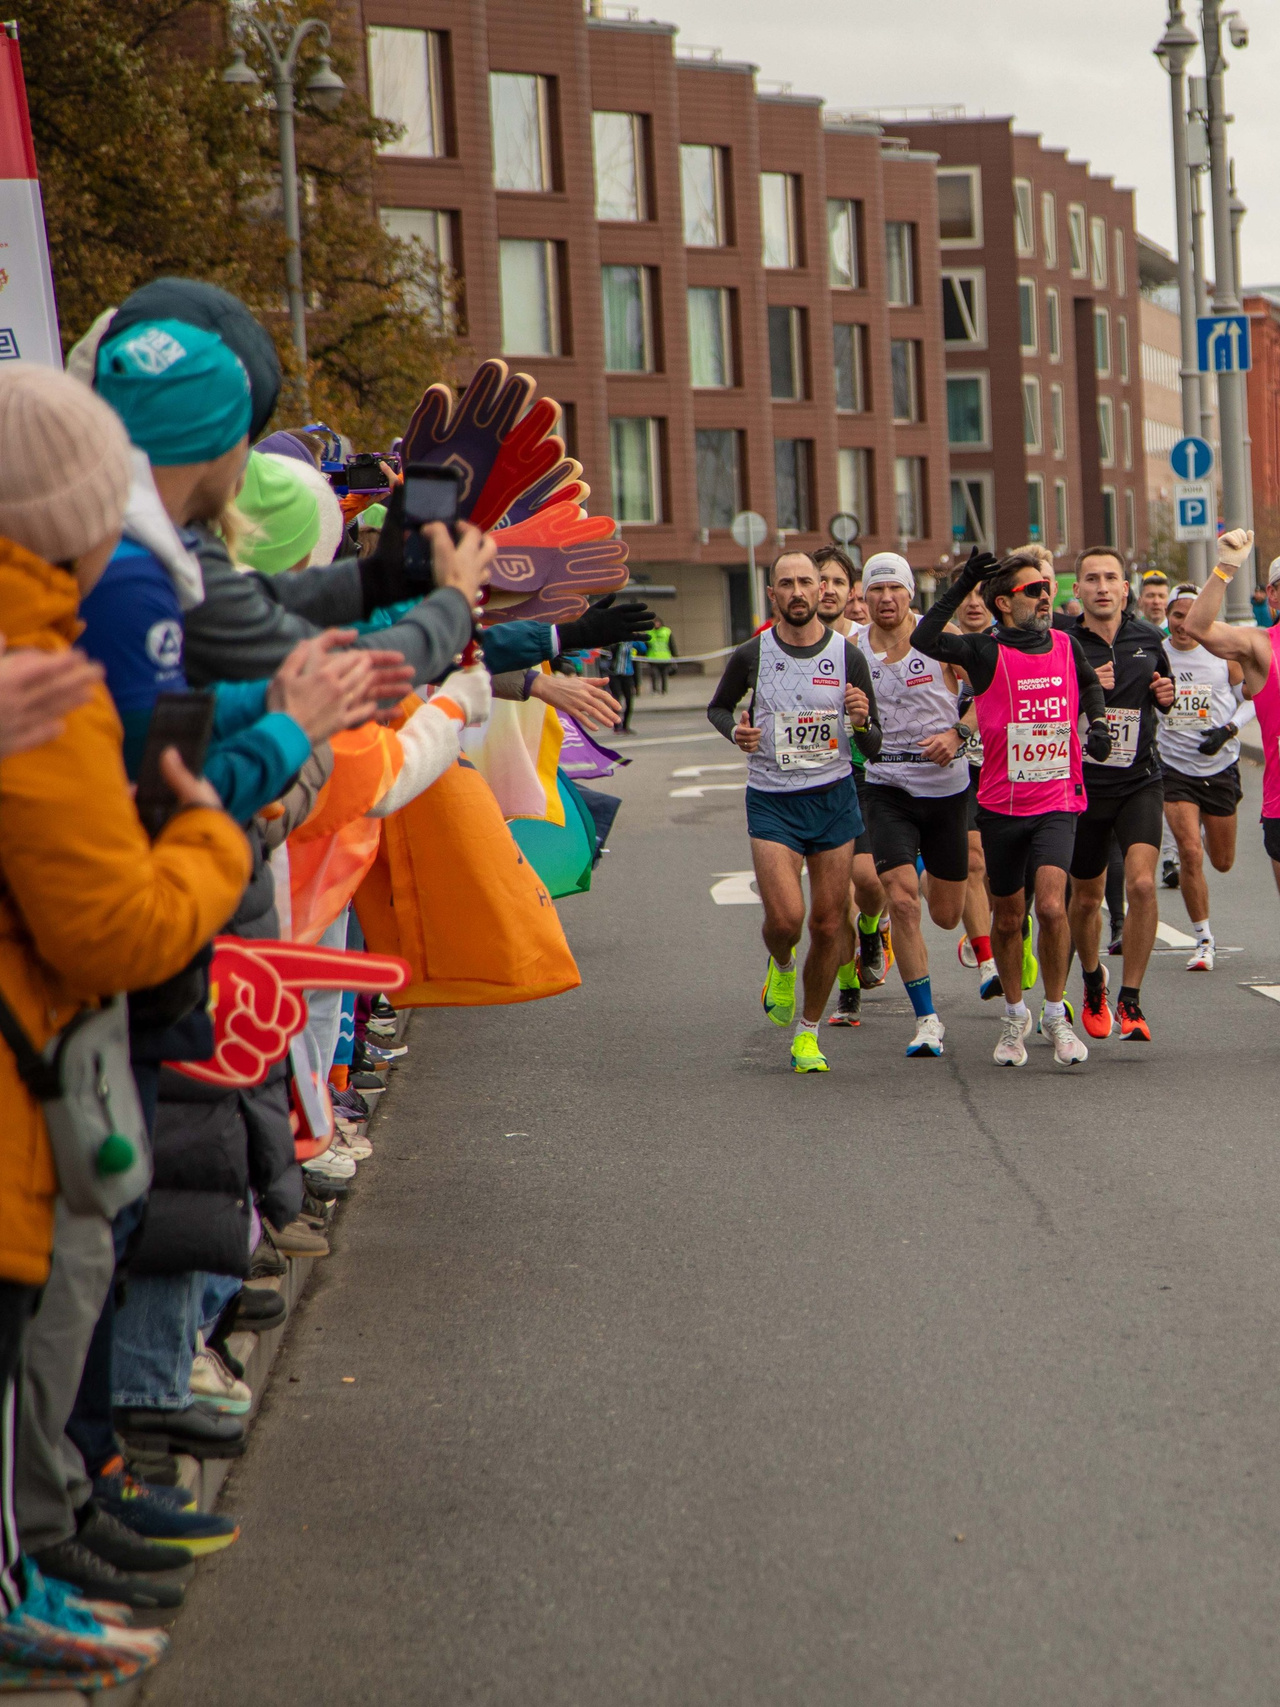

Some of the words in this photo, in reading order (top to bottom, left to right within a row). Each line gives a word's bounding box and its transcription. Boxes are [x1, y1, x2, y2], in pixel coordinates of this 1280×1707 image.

[1186, 501, 1202, 524] P
[907, 676, 932, 686] NUTREND
[1017, 677, 1050, 685] МАРАФОН
[1019, 697, 1061, 721] 2:49
[1173, 697, 1210, 710] 4184
[784, 724, 831, 744] 1978
[1110, 723, 1129, 741] 51
[796, 743, 820, 751] СЕРГЕЙ
[1012, 741, 1067, 761] 16994
[882, 754, 903, 762] NUTR
